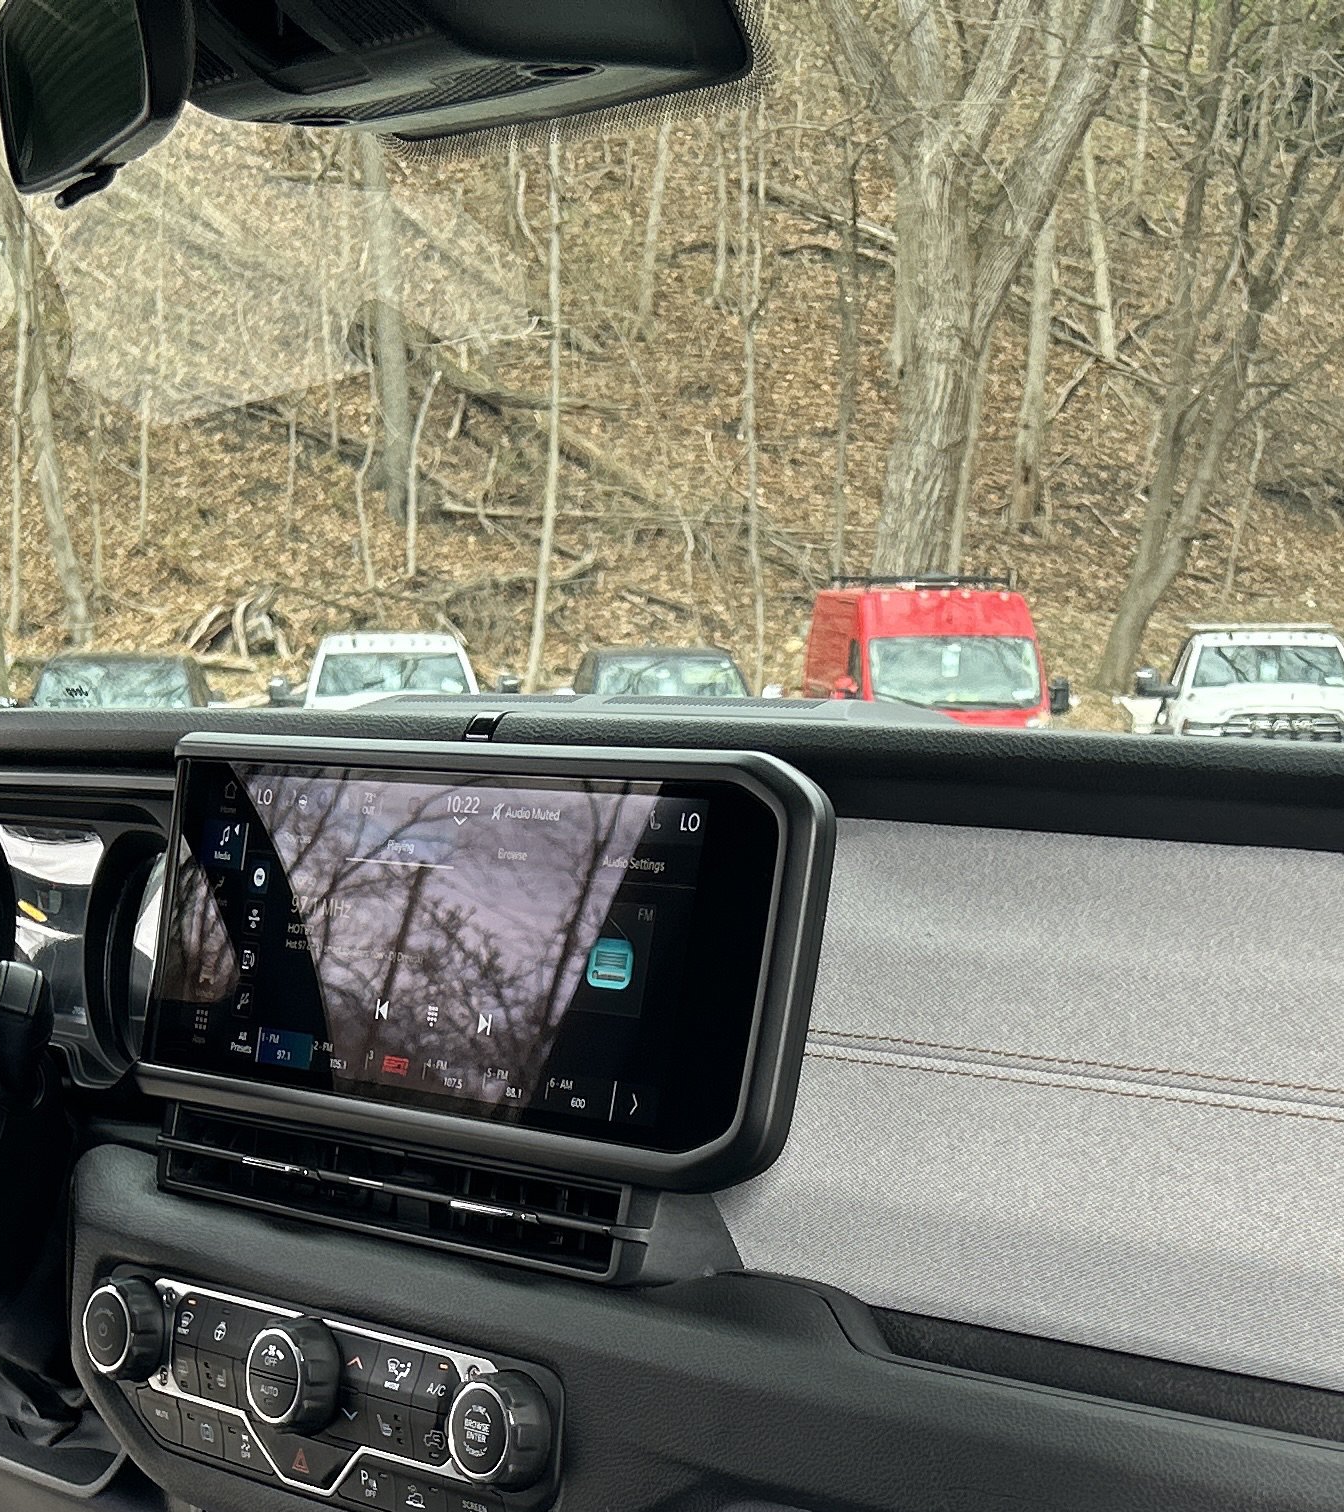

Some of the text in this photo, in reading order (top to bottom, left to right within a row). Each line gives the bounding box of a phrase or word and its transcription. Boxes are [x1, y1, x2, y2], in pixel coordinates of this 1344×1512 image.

[257, 788, 273, 806] LO
[447, 796, 481, 815] 10:22
[505, 807, 561, 822] Audio Muted
[679, 812, 701, 832] LO
[387, 839, 415, 855] Playing
[497, 848, 528, 862] Browse
[602, 855, 665, 874] Audio Settings
[320, 898, 352, 919] MHz
[637, 907, 654, 922] FM
[264, 1356, 278, 1367] OFF
[260, 1384, 279, 1397] AUTO
[426, 1382, 447, 1398] A/C
[464, 1417, 491, 1434] BROWSE
[466, 1430, 487, 1444] ENTER
